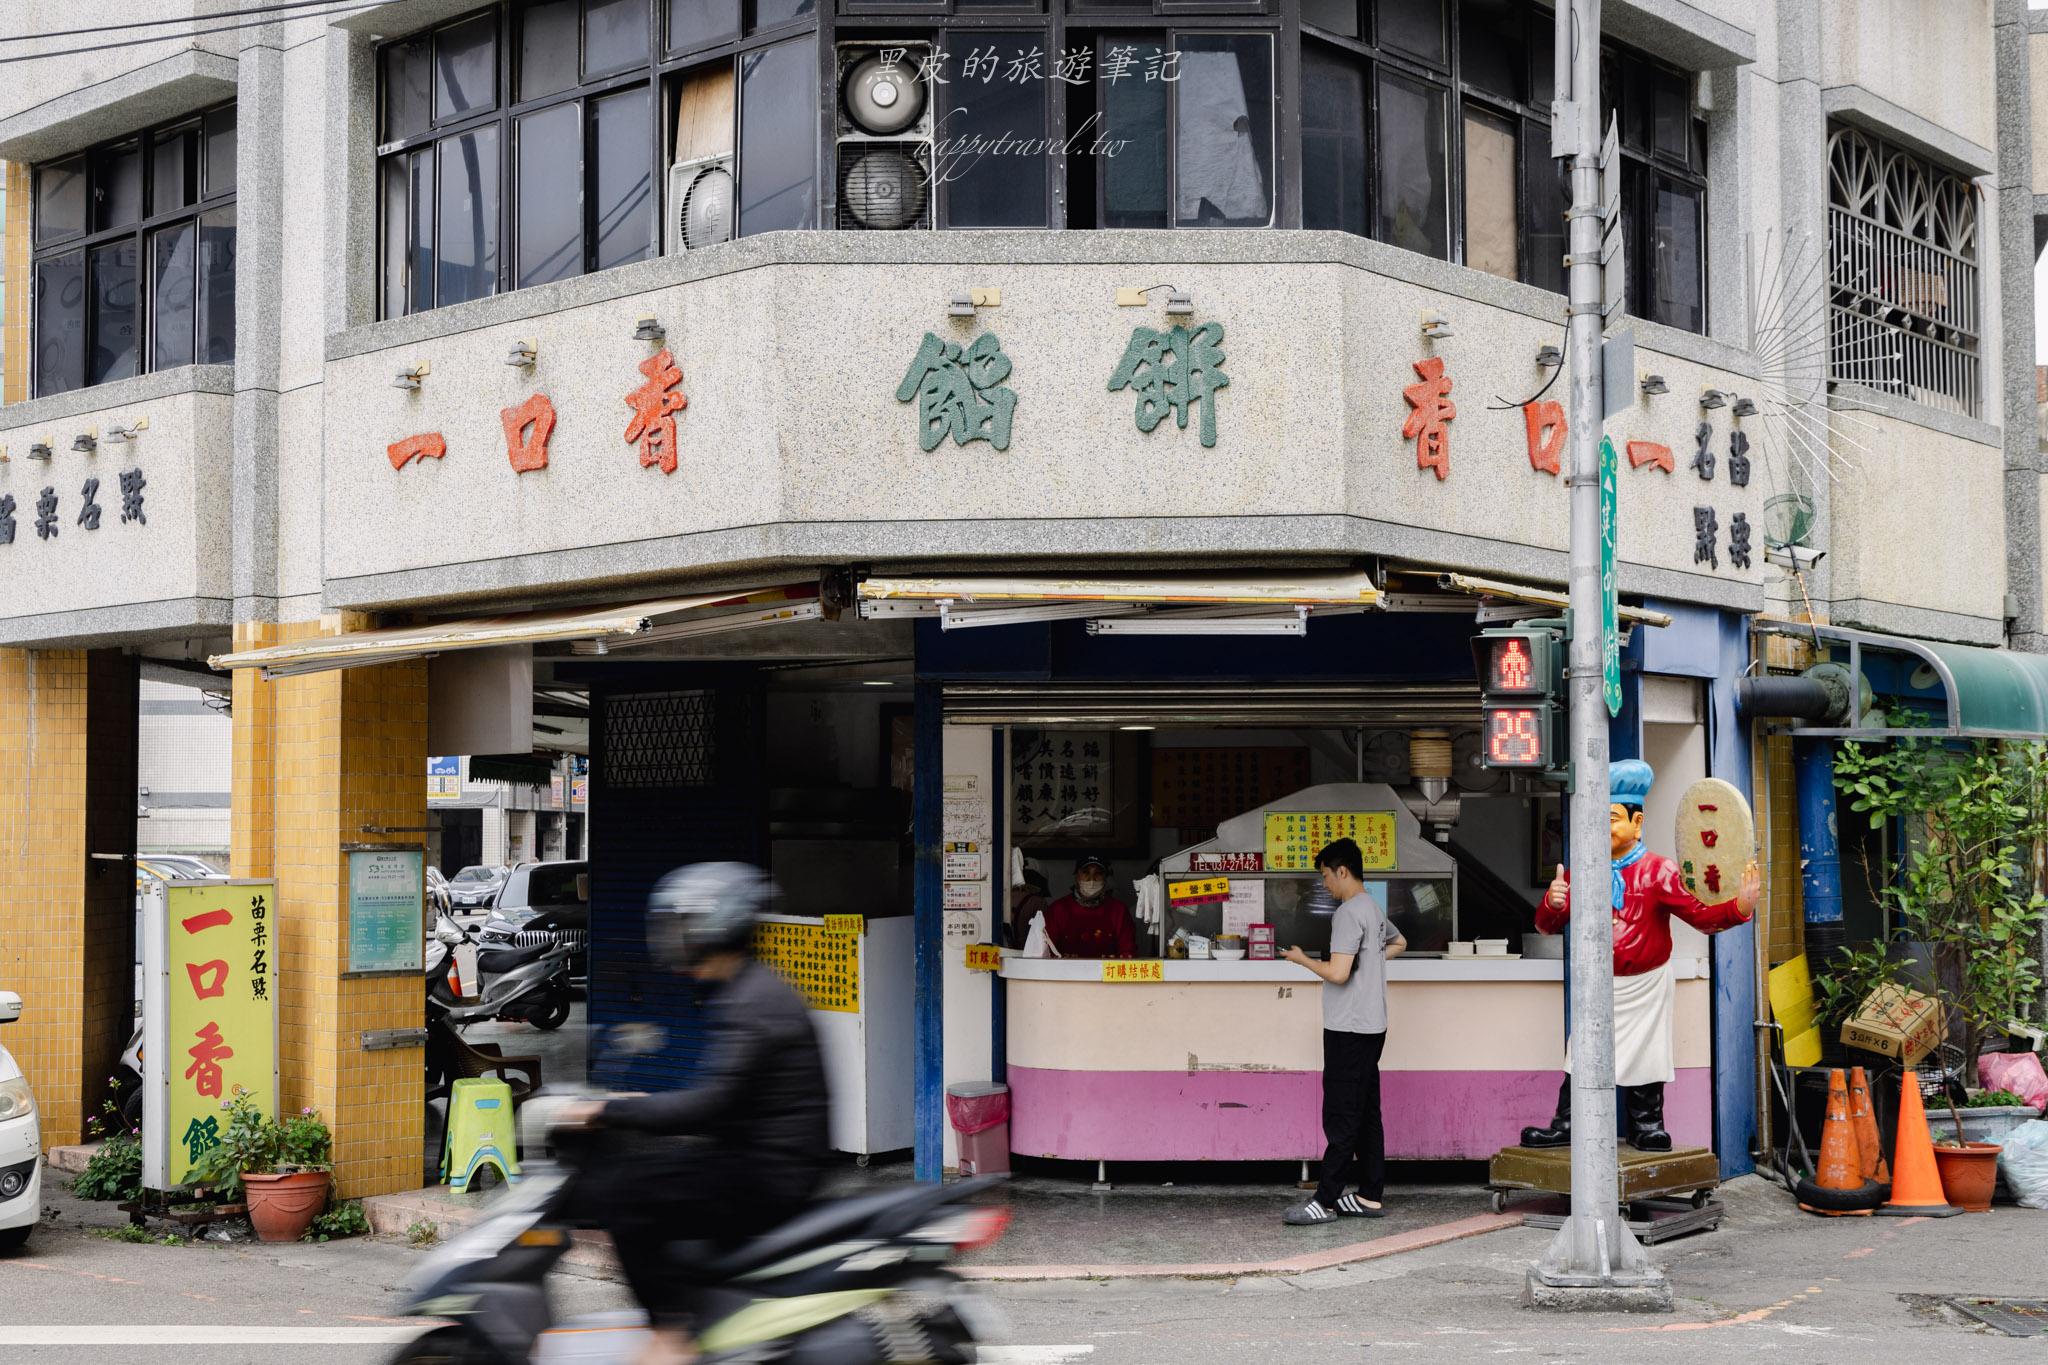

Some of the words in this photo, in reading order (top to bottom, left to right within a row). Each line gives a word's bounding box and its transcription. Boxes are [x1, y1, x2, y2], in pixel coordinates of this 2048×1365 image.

[387, 349, 687, 474] 一口香
[898, 322, 1230, 451] 餡餅
[1491, 711, 1537, 761] 25
[1698, 804, 1721, 893] 一口香
[250, 895, 268, 1001] 苗栗名點
[1105, 962, 1161, 979] 訂購結帳處
[181, 908, 234, 1099] 一口香
